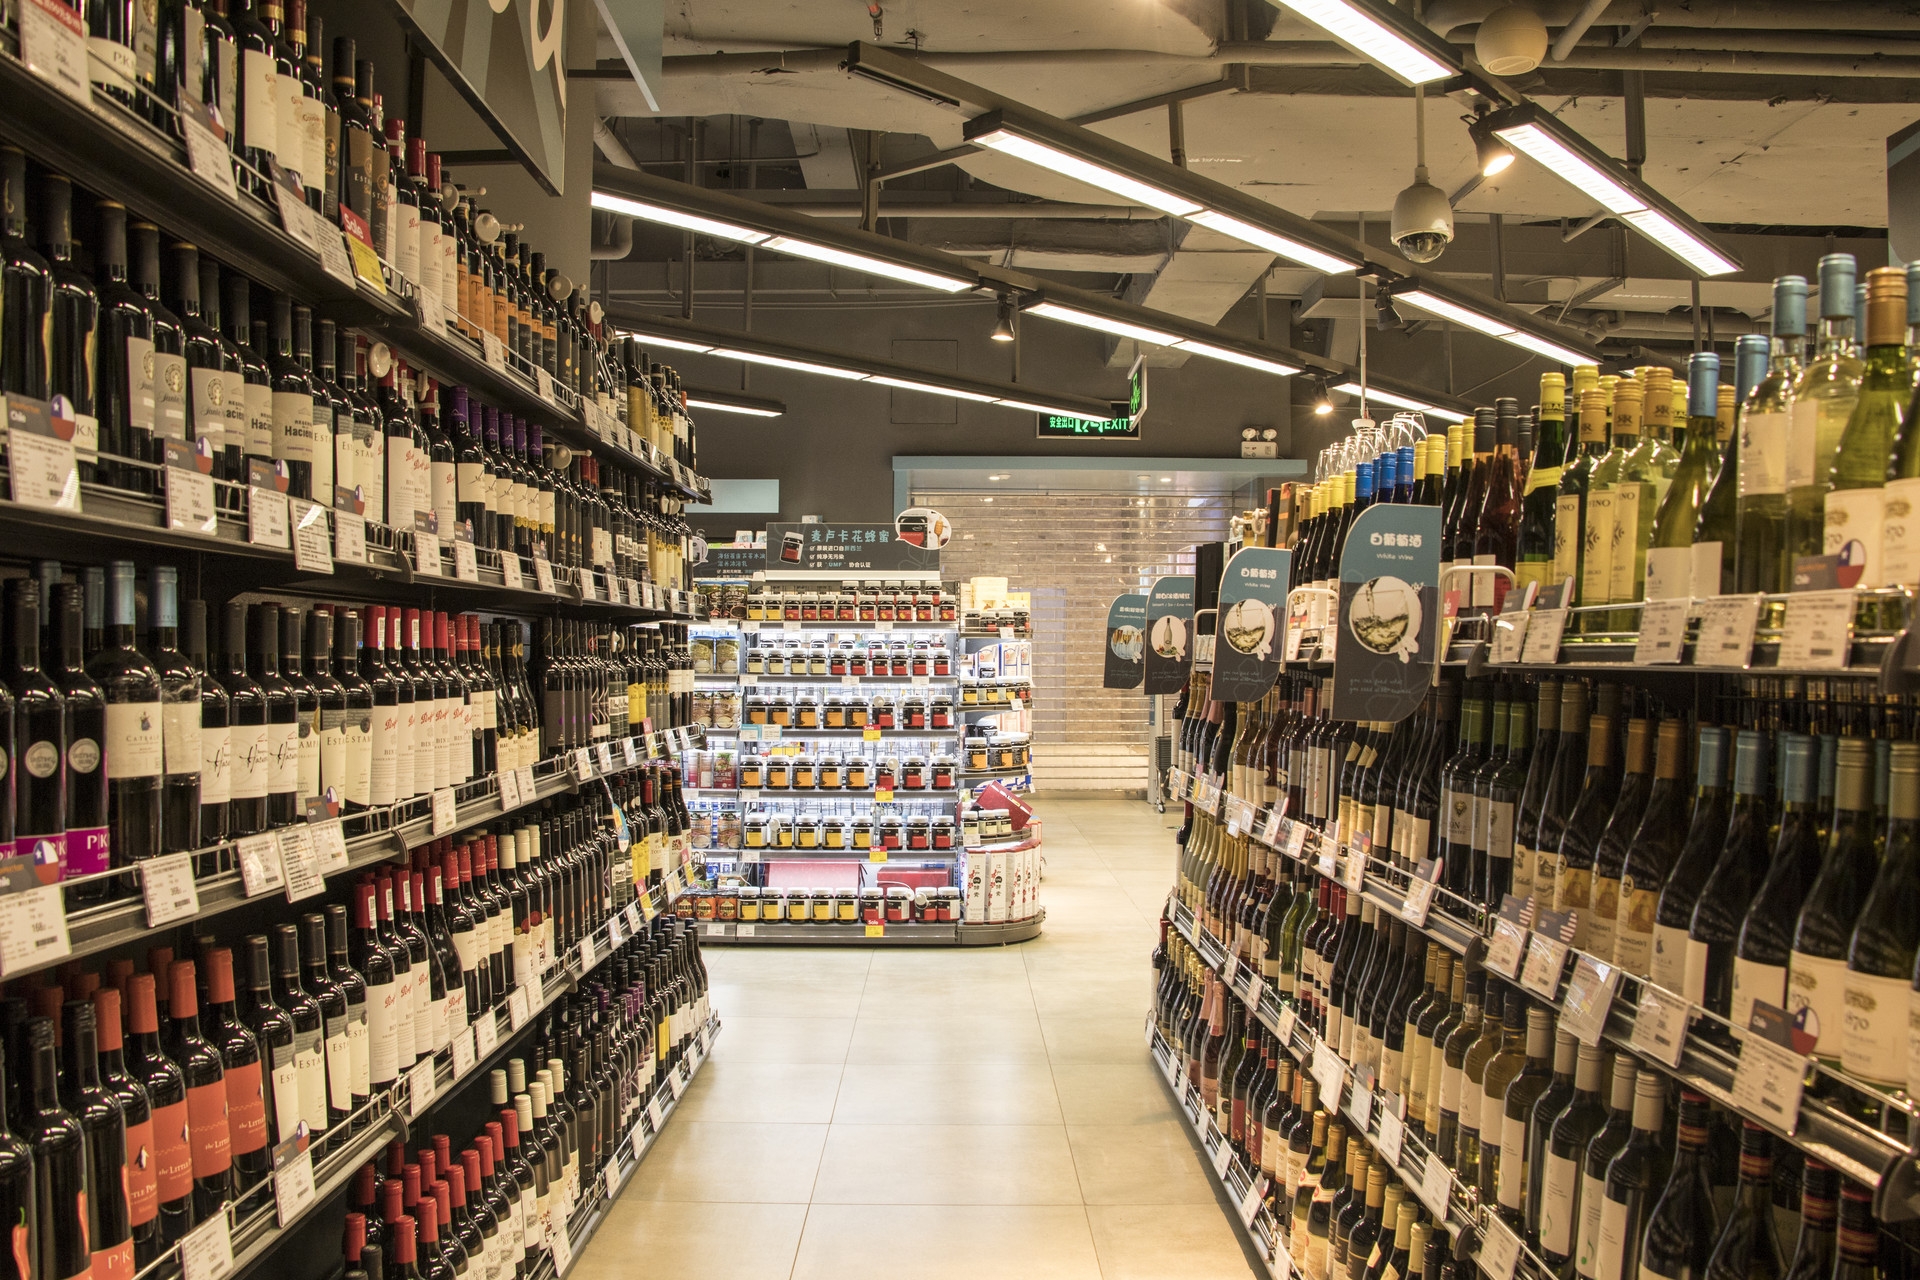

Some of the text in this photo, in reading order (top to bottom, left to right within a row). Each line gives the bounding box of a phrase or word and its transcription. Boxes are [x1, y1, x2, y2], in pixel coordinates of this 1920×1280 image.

[344, 213, 364, 239] Sale
[1050, 416, 1074, 428] 安全出口
[1104, 418, 1128, 430] EXIT
[811, 529, 890, 543] 麦卢卡花蜂蜜
[1370, 532, 1422, 547] 白葡萄酒
[1376, 552, 1396, 560] White
[1241, 567, 1277, 580] 白葡萄酒
